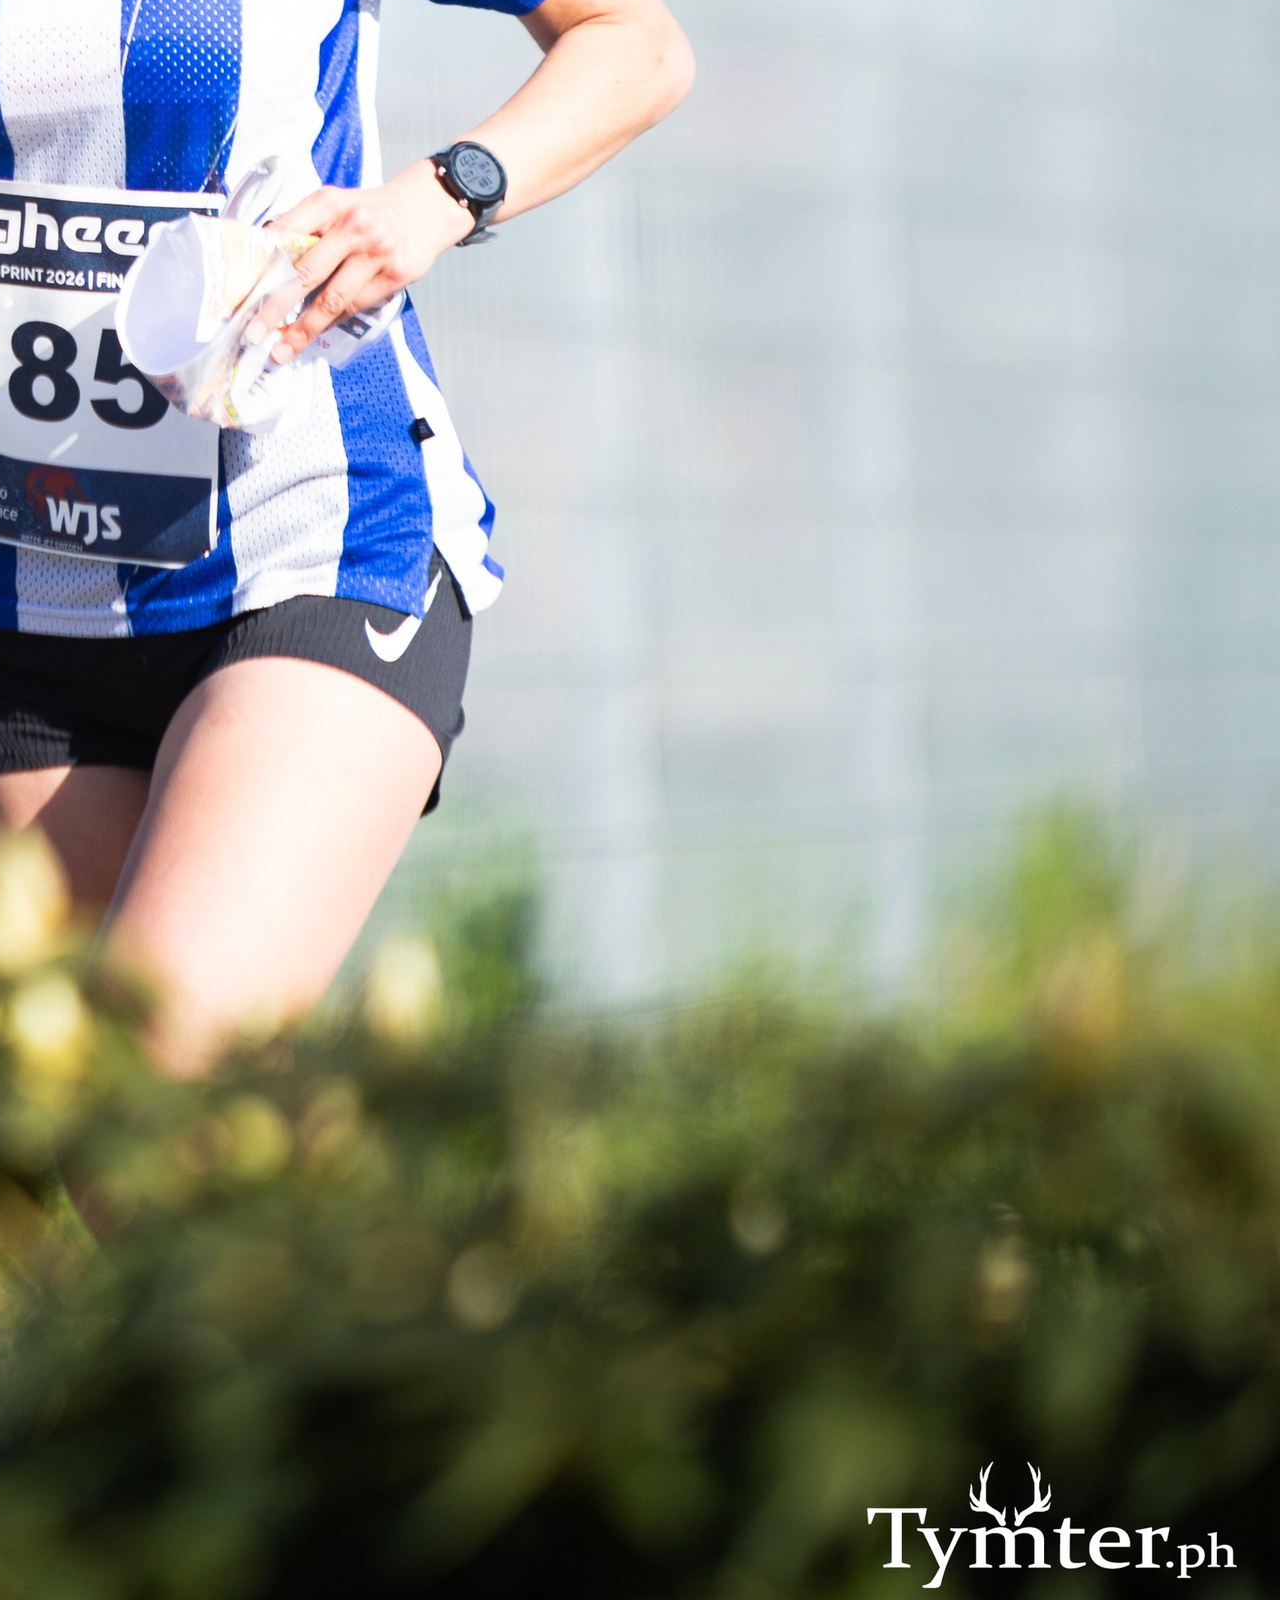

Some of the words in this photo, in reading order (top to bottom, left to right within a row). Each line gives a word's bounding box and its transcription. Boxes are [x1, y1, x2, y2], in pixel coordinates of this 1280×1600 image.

[46, 270, 86, 288] 2026
[96, 271, 125, 289] FIN
[46, 496, 122, 546] WJS
